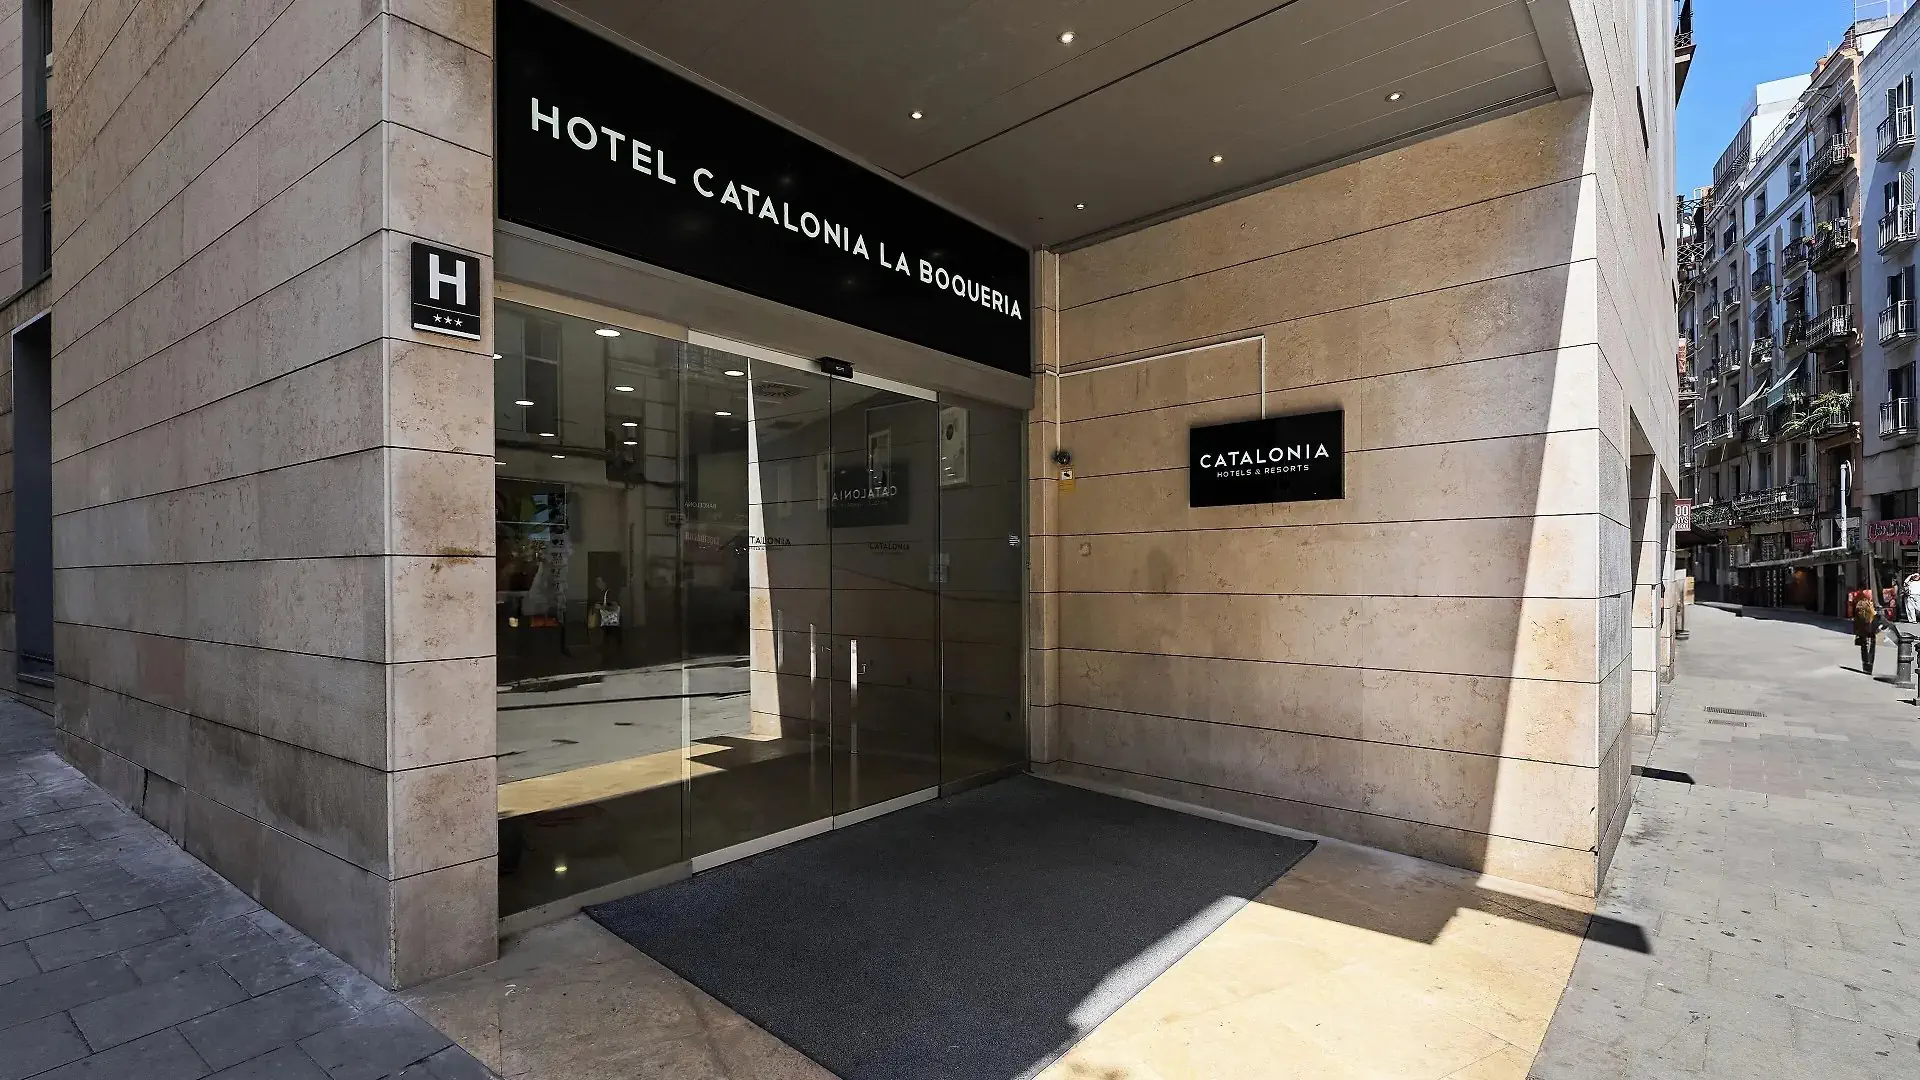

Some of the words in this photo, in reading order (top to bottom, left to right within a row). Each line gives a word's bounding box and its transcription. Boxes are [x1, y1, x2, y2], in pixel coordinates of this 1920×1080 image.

[531, 97, 677, 185] HOTEL
[693, 167, 870, 260] CATALONIA
[880, 242, 911, 276] LA
[919, 259, 1022, 320] BOQUERIA
[429, 253, 466, 306] H
[1200, 442, 1330, 469] CATALONIA
[1217, 468, 1252, 478] HOTELS
[1265, 464, 1310, 474] RESORTS
[1675, 505, 1689, 516] 00
[1675, 516, 1689, 524] NYS
[749, 535, 792, 545] TALONIA
